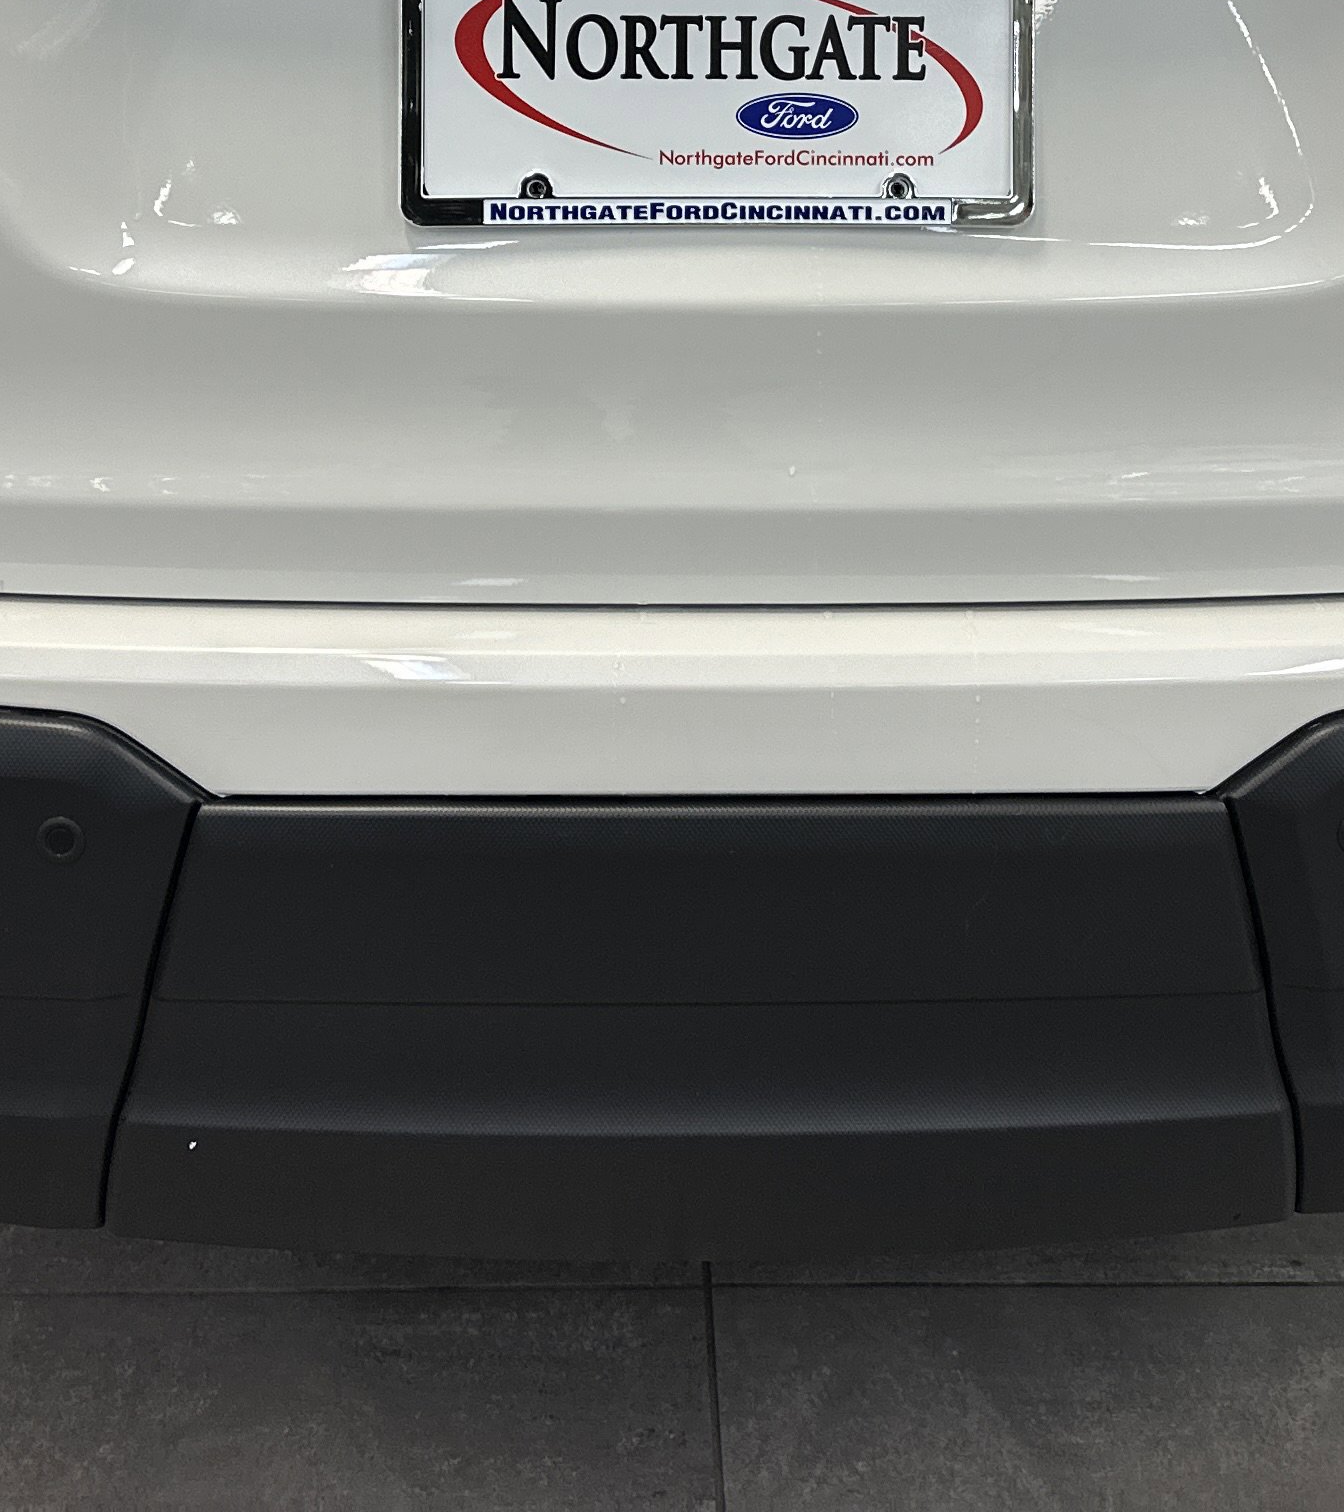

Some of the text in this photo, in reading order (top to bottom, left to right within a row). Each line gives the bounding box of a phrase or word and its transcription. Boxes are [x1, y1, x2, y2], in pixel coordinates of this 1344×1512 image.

[760, 96, 832, 132] Ford
[659, 150, 935, 169] NorthgateFordCincinnati.com
[489, 201, 946, 223] NORTHGATEFORDCINCINNATI.COM
